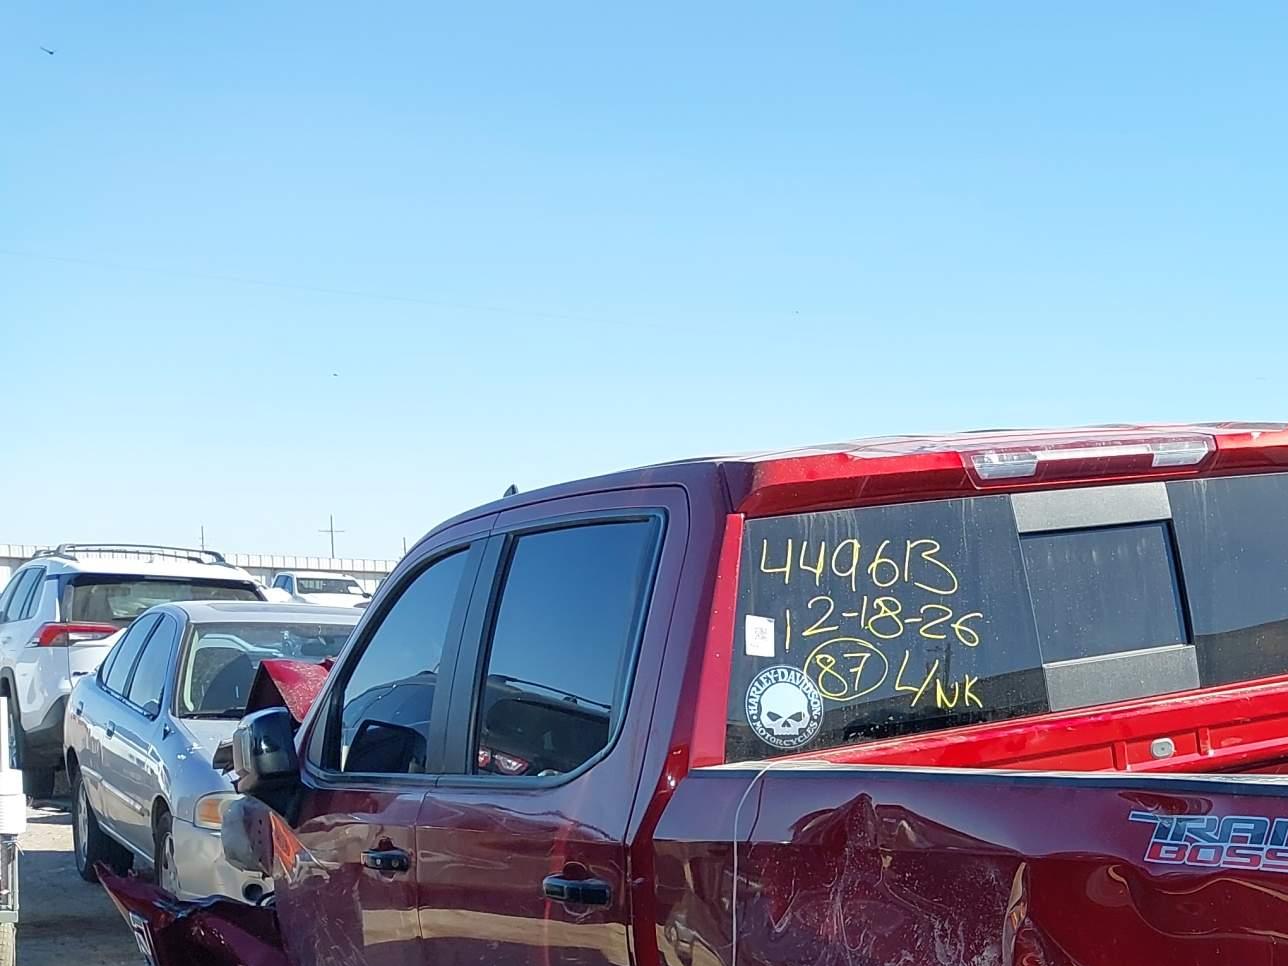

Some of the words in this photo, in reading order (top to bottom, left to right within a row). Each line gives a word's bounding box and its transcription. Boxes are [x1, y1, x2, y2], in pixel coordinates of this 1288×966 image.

[760, 538, 958, 595] 4496B
[785, 595, 984, 653] 12-18-26
[748, 668, 821, 717] HARLEY-DAVIDSON
[815, 652, 872, 697] 87
[752, 720, 818, 746] MOTORCYCLES
